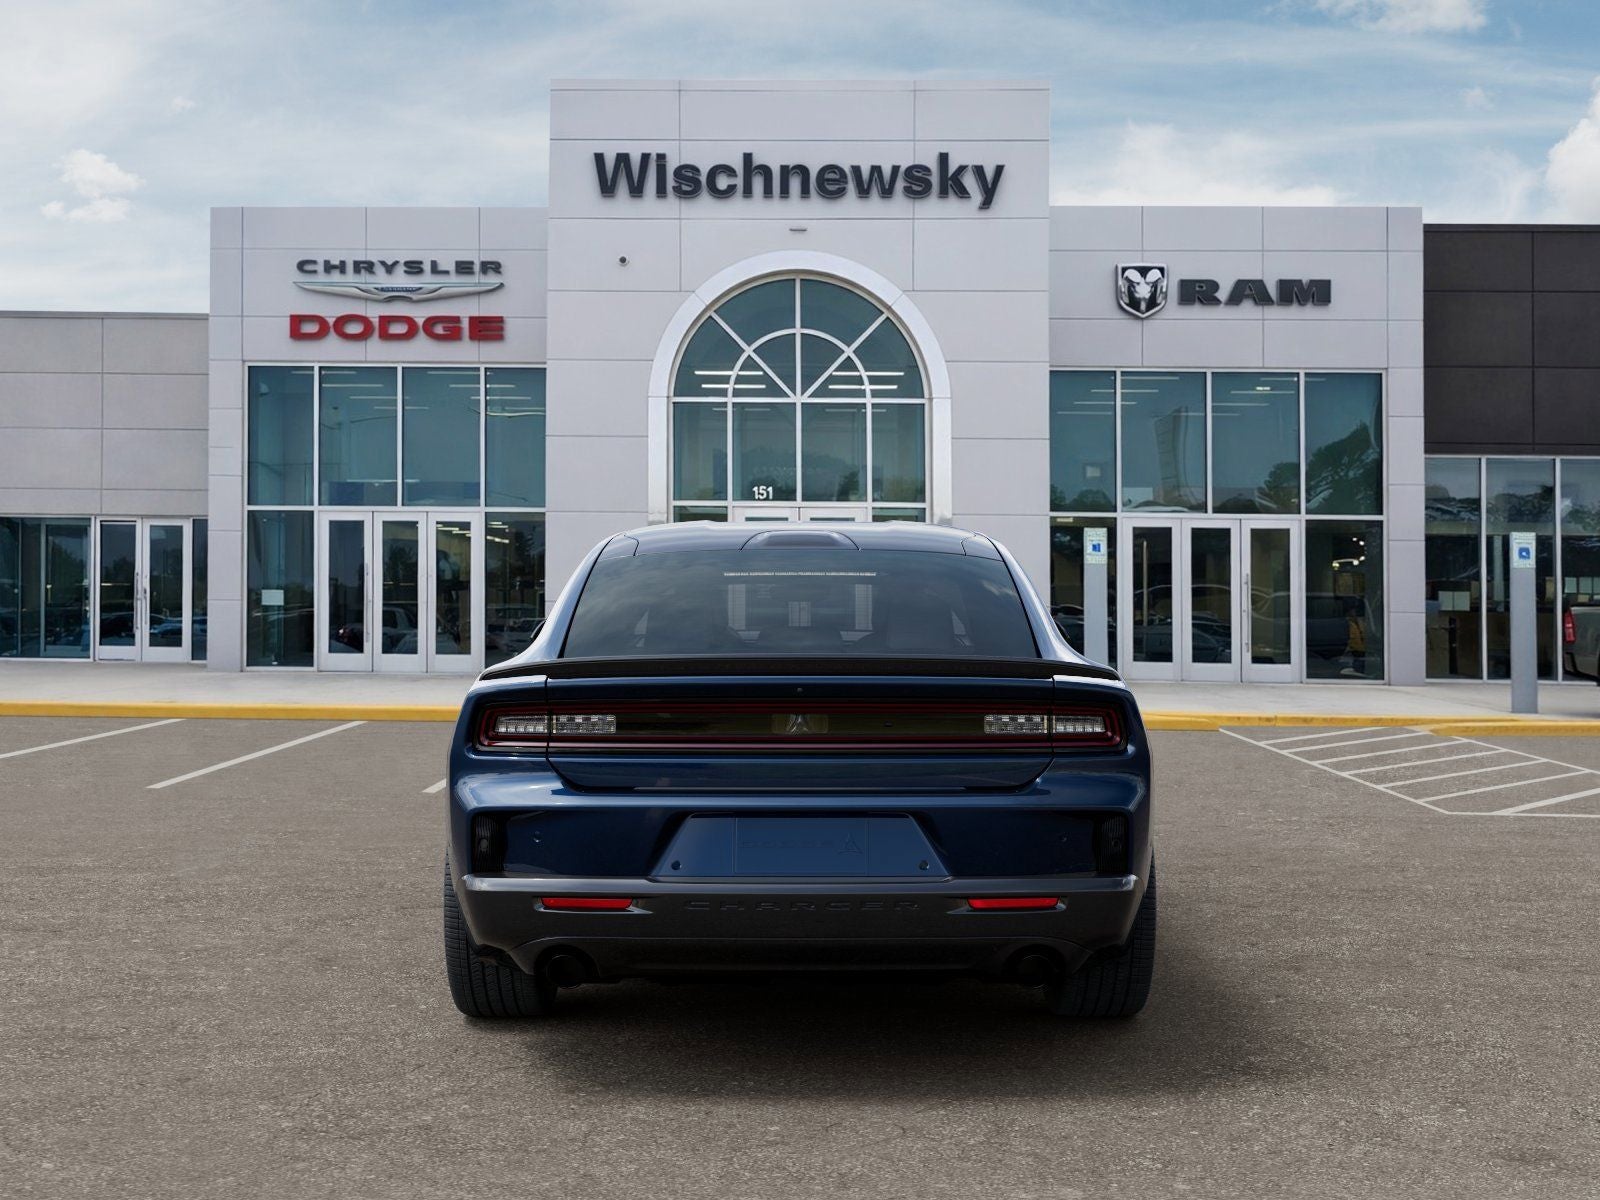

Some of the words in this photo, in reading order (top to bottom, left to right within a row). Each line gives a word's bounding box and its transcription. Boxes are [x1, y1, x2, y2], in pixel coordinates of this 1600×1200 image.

[593, 151, 1006, 209] Wischnewsky
[296, 259, 503, 275] CHRYSLER
[1178, 279, 1332, 305] RAM
[289, 314, 505, 341] DODGE
[752, 485, 773, 500] 151
